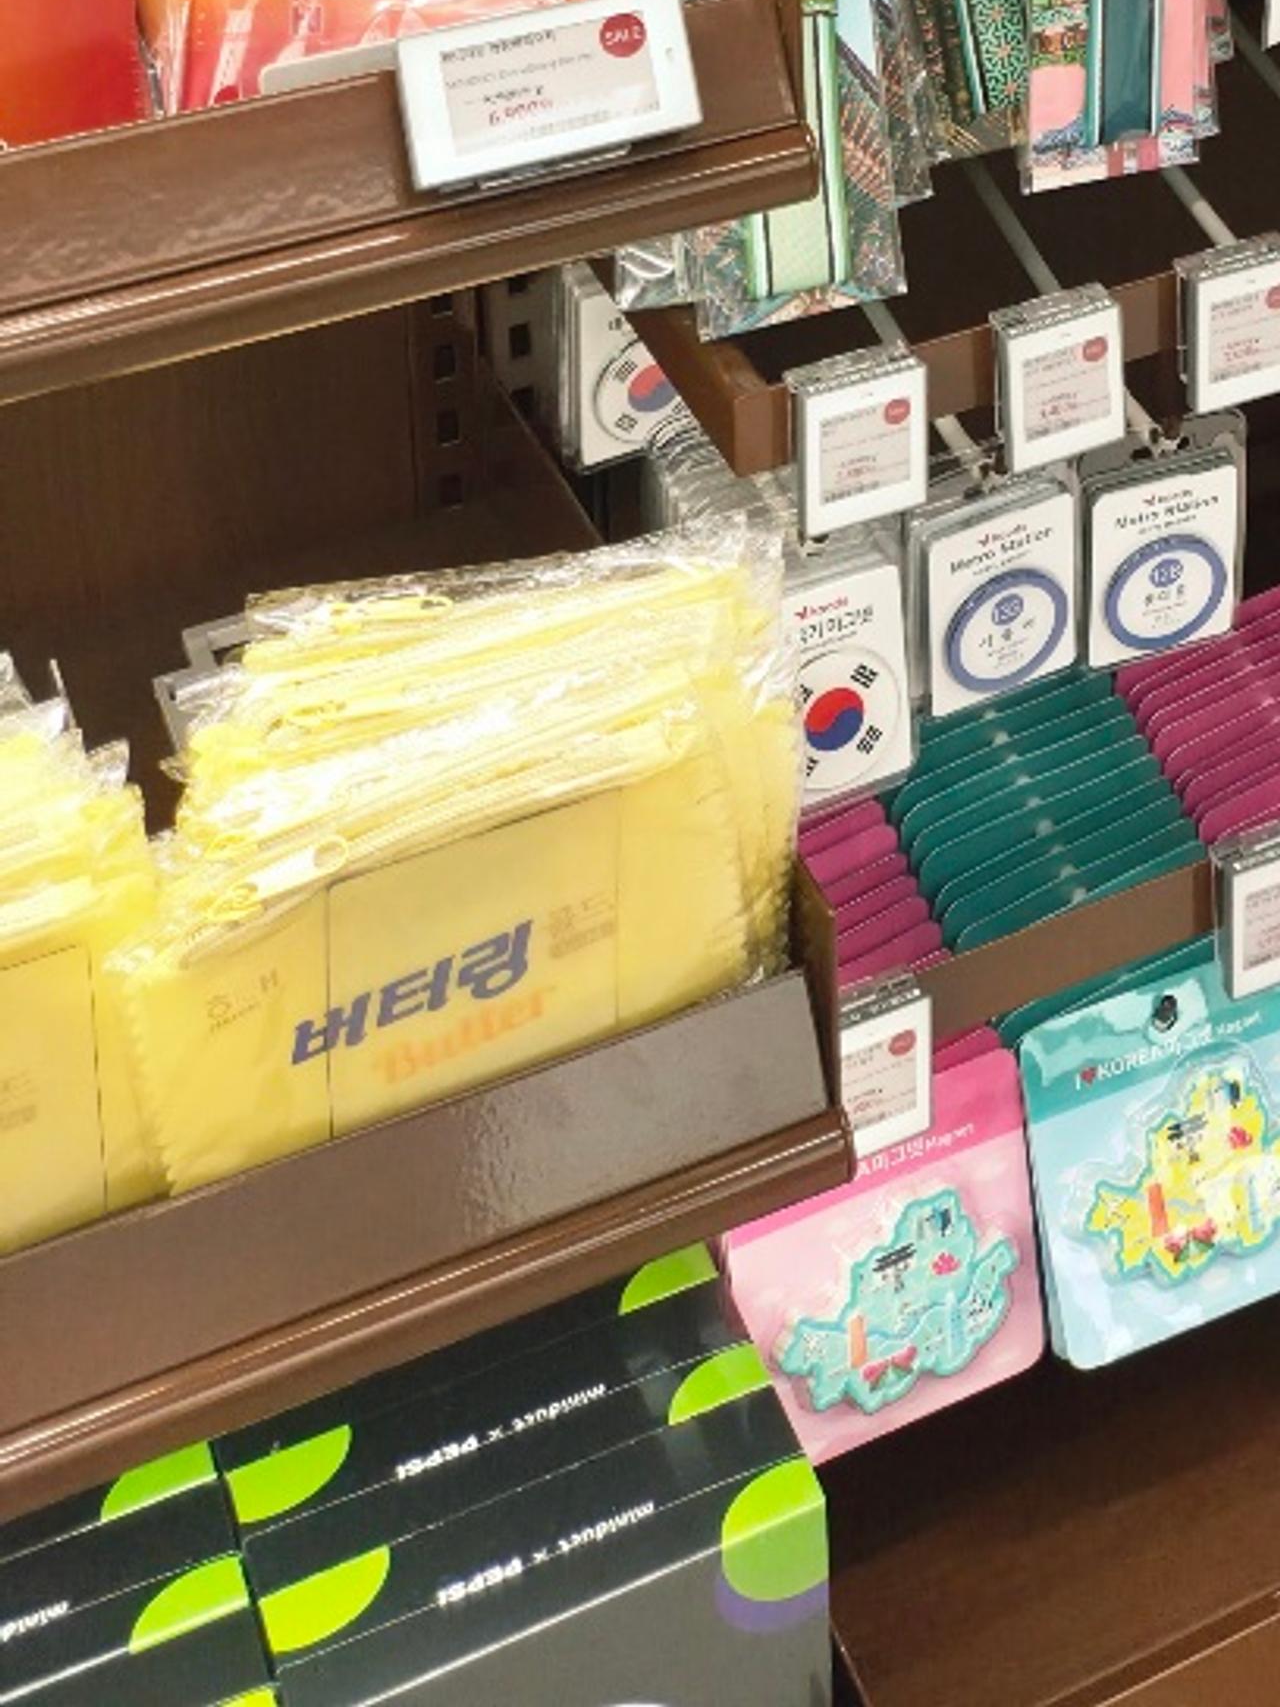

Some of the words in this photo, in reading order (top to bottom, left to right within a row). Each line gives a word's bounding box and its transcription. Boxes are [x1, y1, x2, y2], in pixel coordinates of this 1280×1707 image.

[290, 918, 534, 1065] 버터링
[511, 1382, 607, 1431] miniduct
[395, 1434, 479, 1481] PEPSI
[557, 1499, 655, 1555] miniduct
[436, 1557, 524, 1608] PEPSI
